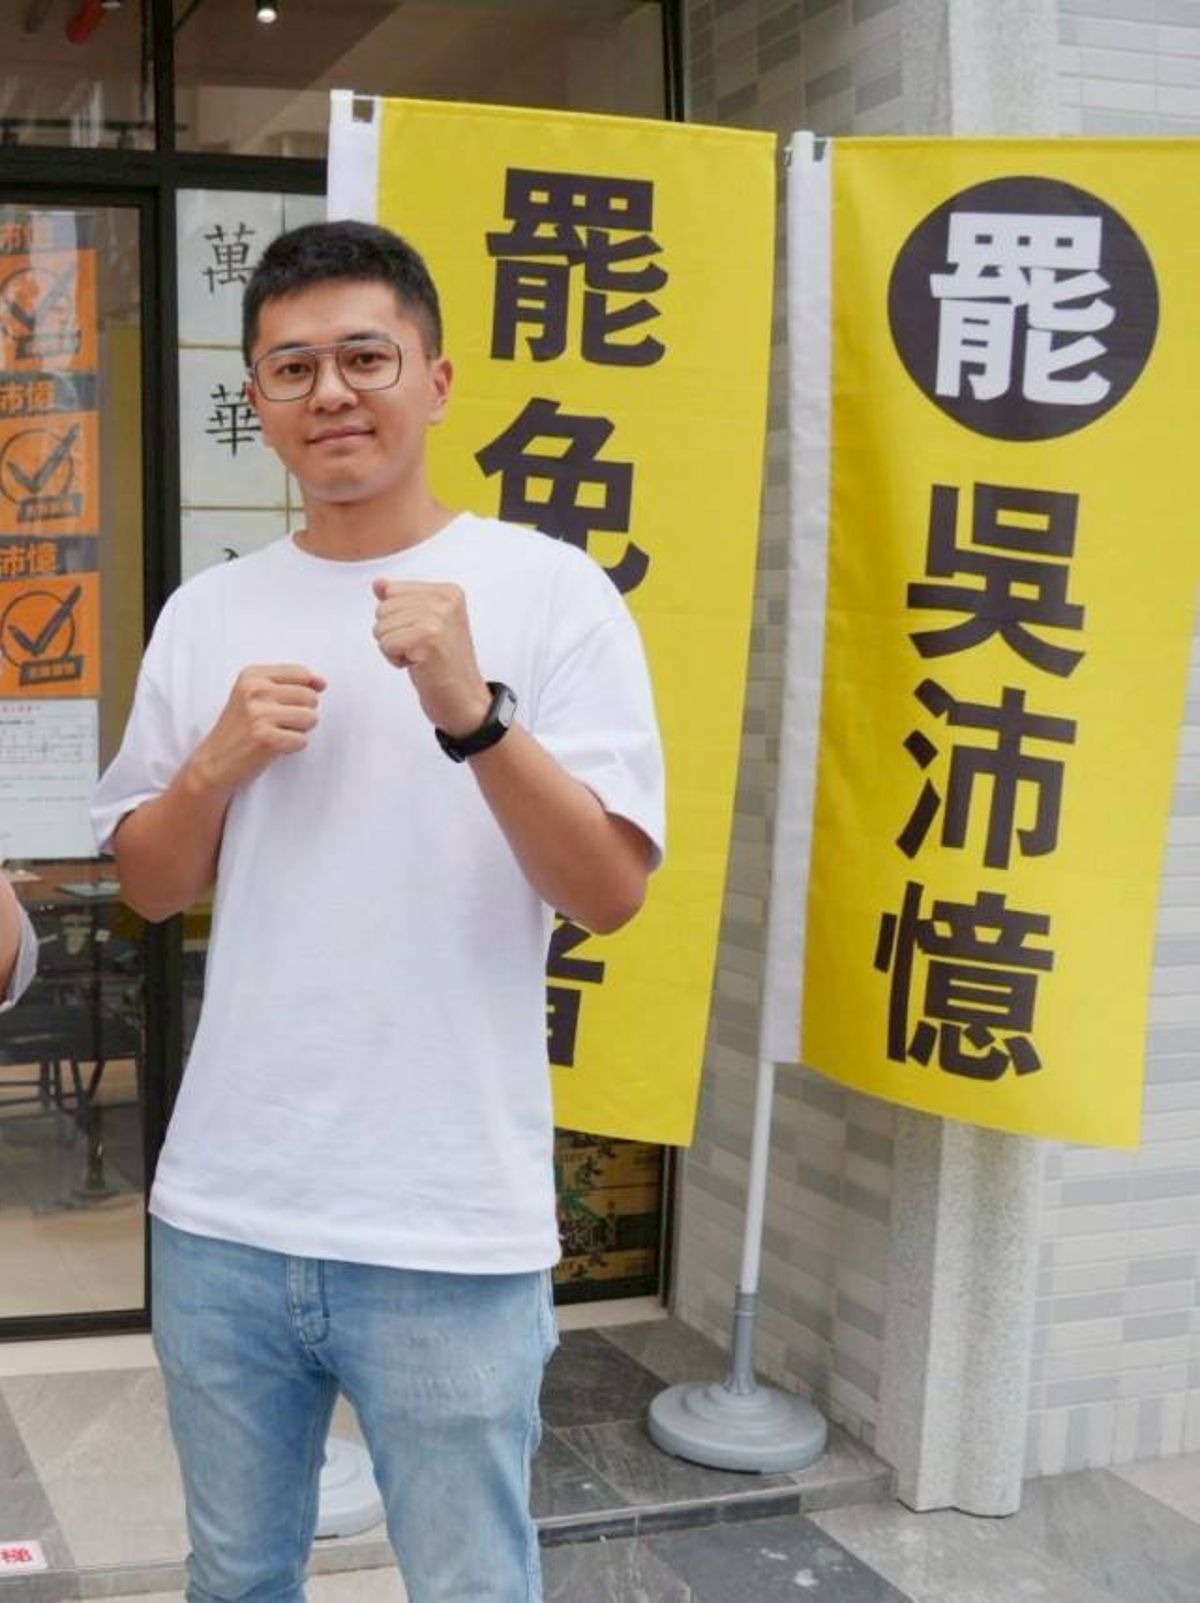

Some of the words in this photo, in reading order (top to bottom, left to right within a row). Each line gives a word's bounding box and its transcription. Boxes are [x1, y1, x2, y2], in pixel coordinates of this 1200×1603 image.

[203, 221, 263, 560] 萬華
[929, 211, 1116, 406] 罷
[873, 483, 1087, 1081] 吳沛憶
